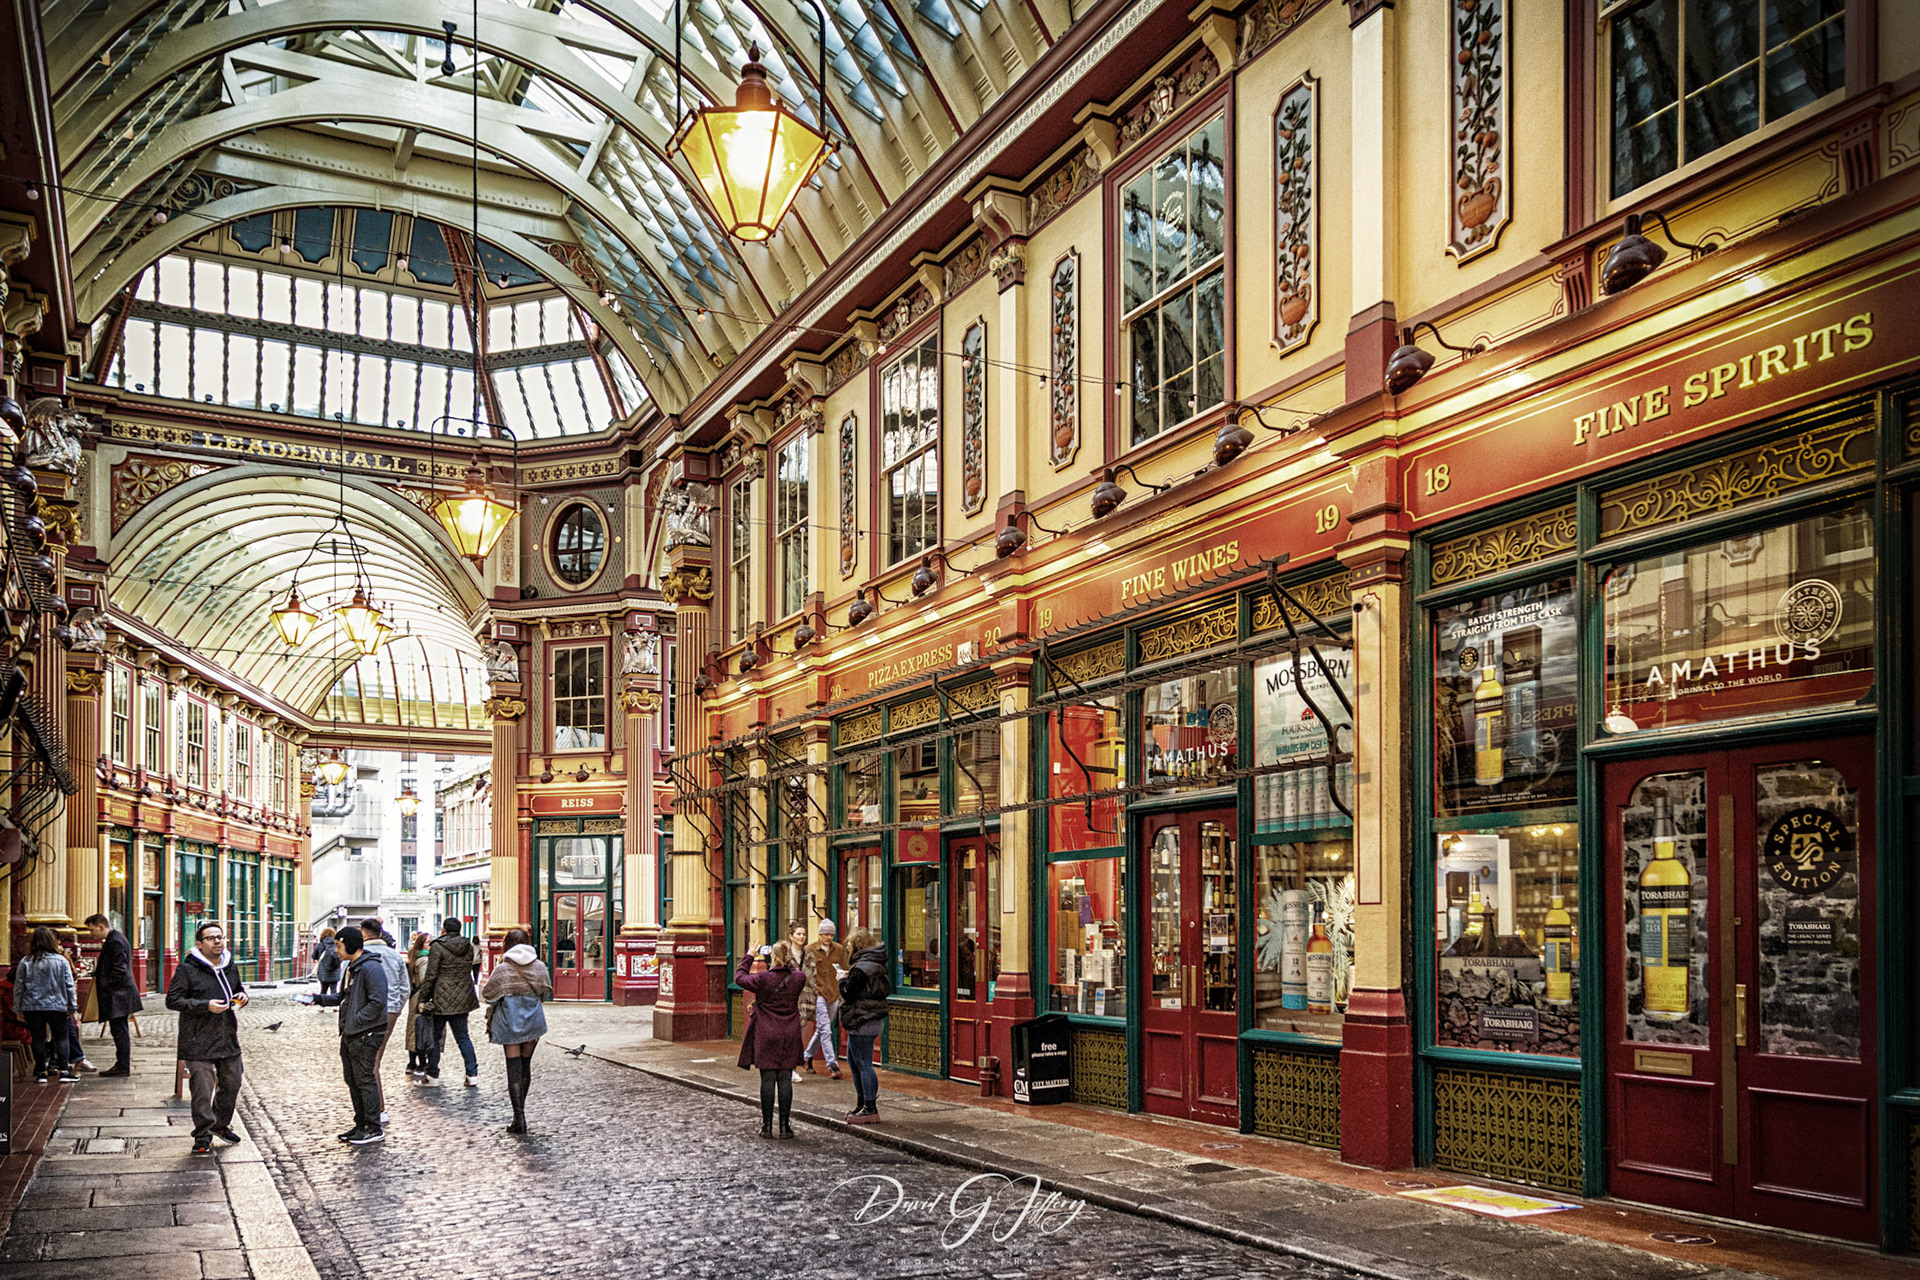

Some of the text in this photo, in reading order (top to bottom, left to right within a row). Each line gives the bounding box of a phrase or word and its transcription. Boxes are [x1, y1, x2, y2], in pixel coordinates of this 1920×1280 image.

[1573, 311, 1875, 446] FINE SPIRITS
[202, 432, 410, 474] LEADENHALL
[1424, 463, 1451, 497] 18
[1315, 504, 1340, 535] 19
[1121, 540, 1240, 601] FINE WINES
[1040, 608, 1053, 630] 19
[1451, 606, 1563, 640] STRAIGHT FROM THE CASK
[1467, 601, 1543, 627] BATCH STRENGTH
[985, 627, 1002, 649] 20
[868, 643, 953, 689] PIZZAEXPRESS
[1646, 638, 1822, 688] AMATHUS
[830, 683, 842, 701] 20
[1677, 685, 1710, 696] DRINKS
[1727, 678, 1745, 687] THE
[1748, 673, 1783, 685] WORLD
[1152, 741, 1229, 767] AMATHUS
[560, 798, 594, 808] REISS
[1773, 813, 1841, 844] SPECIAL
[560, 857, 600, 867] REISS
[1773, 861, 1841, 889] EDITION
[1640, 890, 1689, 900] TORABHAIG
[1462, 957, 1515, 968] TORABHAIG
[1483, 1017, 1534, 1030] TORABHAIG
[1041, 1042, 1058, 1051] free
[1045, 1078, 1070, 1086] MATTERS
